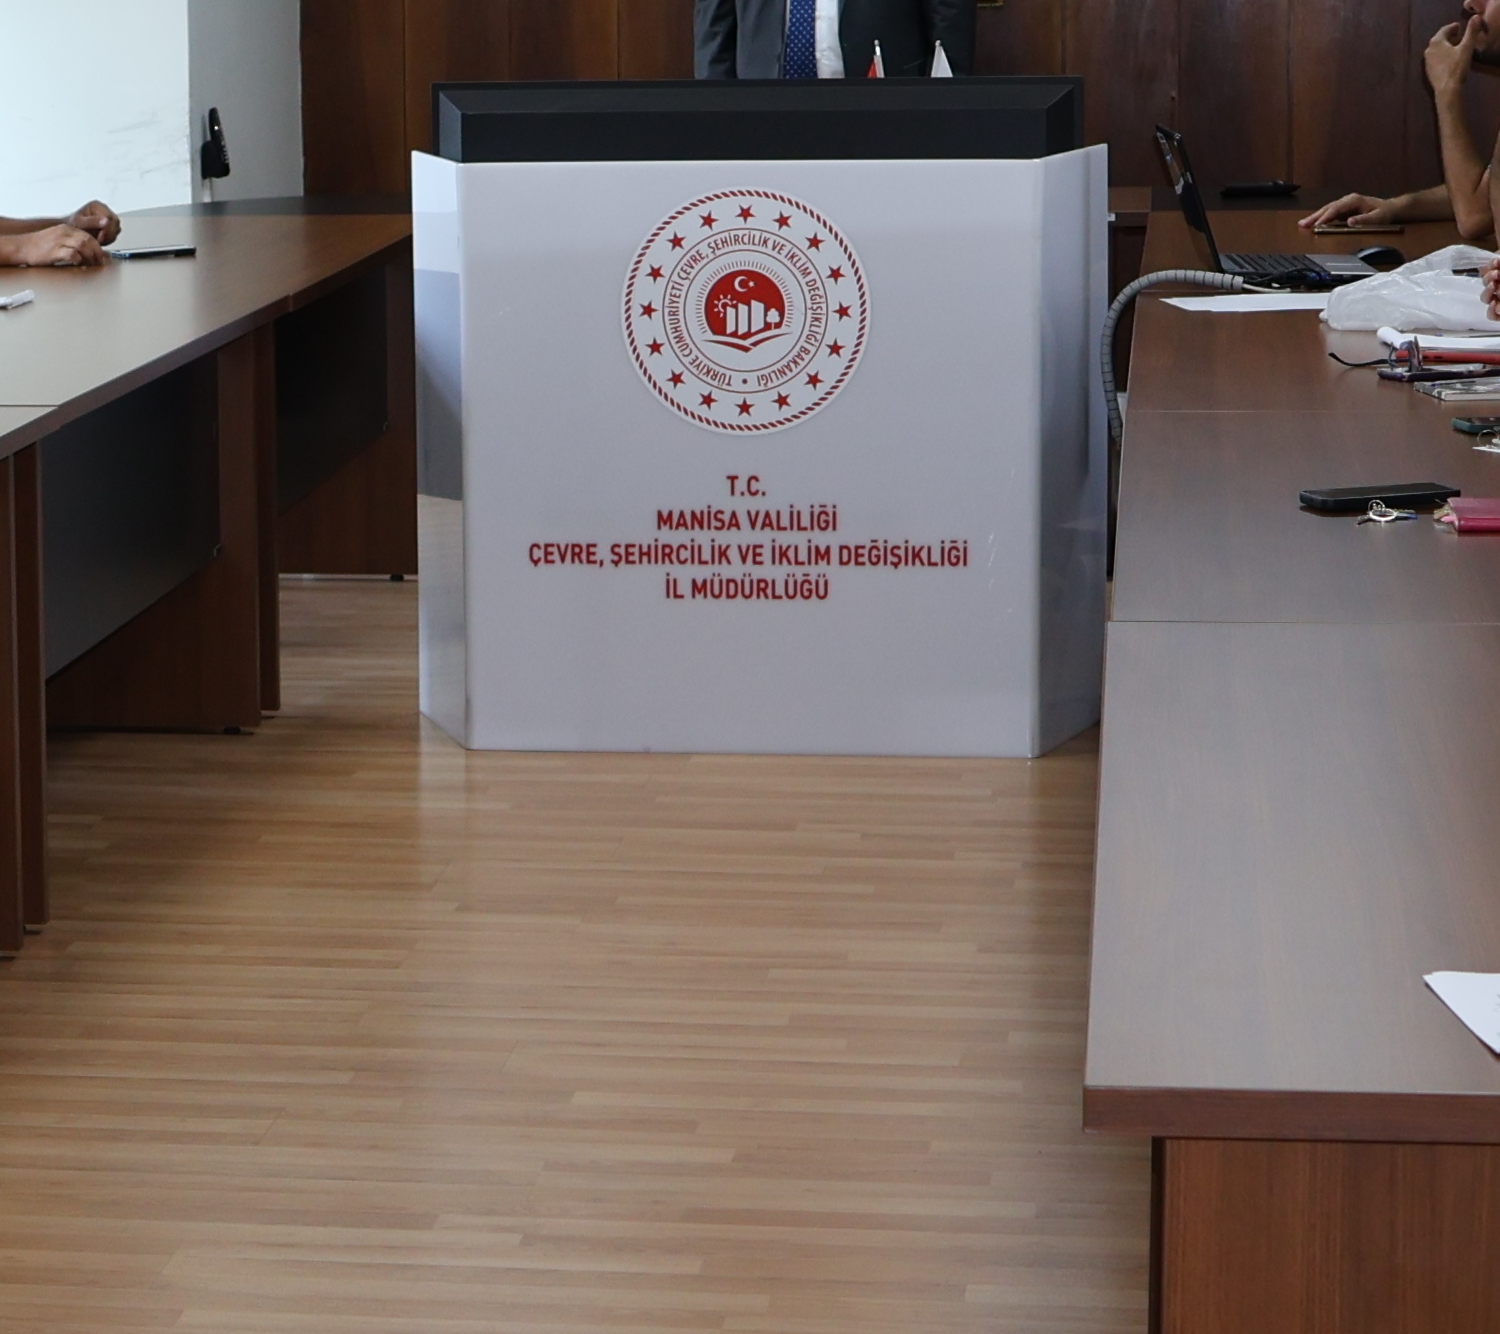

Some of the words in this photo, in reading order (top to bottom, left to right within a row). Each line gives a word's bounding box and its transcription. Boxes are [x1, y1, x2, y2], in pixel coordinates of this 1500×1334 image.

[707, 230, 769, 256] ŞEHİRCİLİK
[771, 238, 787, 256] VE
[677, 249, 709, 282] ÇEVRE,
[784, 246, 813, 280] İKLİM
[665, 280, 693, 358] CUMHURİYETİ
[805, 278, 826, 348] DEĞİŞİKLİĞİ
[688, 354, 733, 387] TÜRKİYE
[757, 345, 811, 388] BAKANLIĞI
[726, 475, 767, 497] T.C.
[656, 504, 742, 531] MANİSA
[746, 504, 838, 531] VALİLİĞİ
[528, 543, 604, 568] ÇEVRE,
[610, 538, 731, 568] ŞEHİRCİLİK
[738, 543, 764, 566] VE
[771, 539, 832, 566] İKLİM
[838, 539, 968, 569] DEĞİŞİKLİĞİ
[665, 573, 684, 599] İL
[691, 573, 830, 600] MÜDÜRLÜĞÜ
